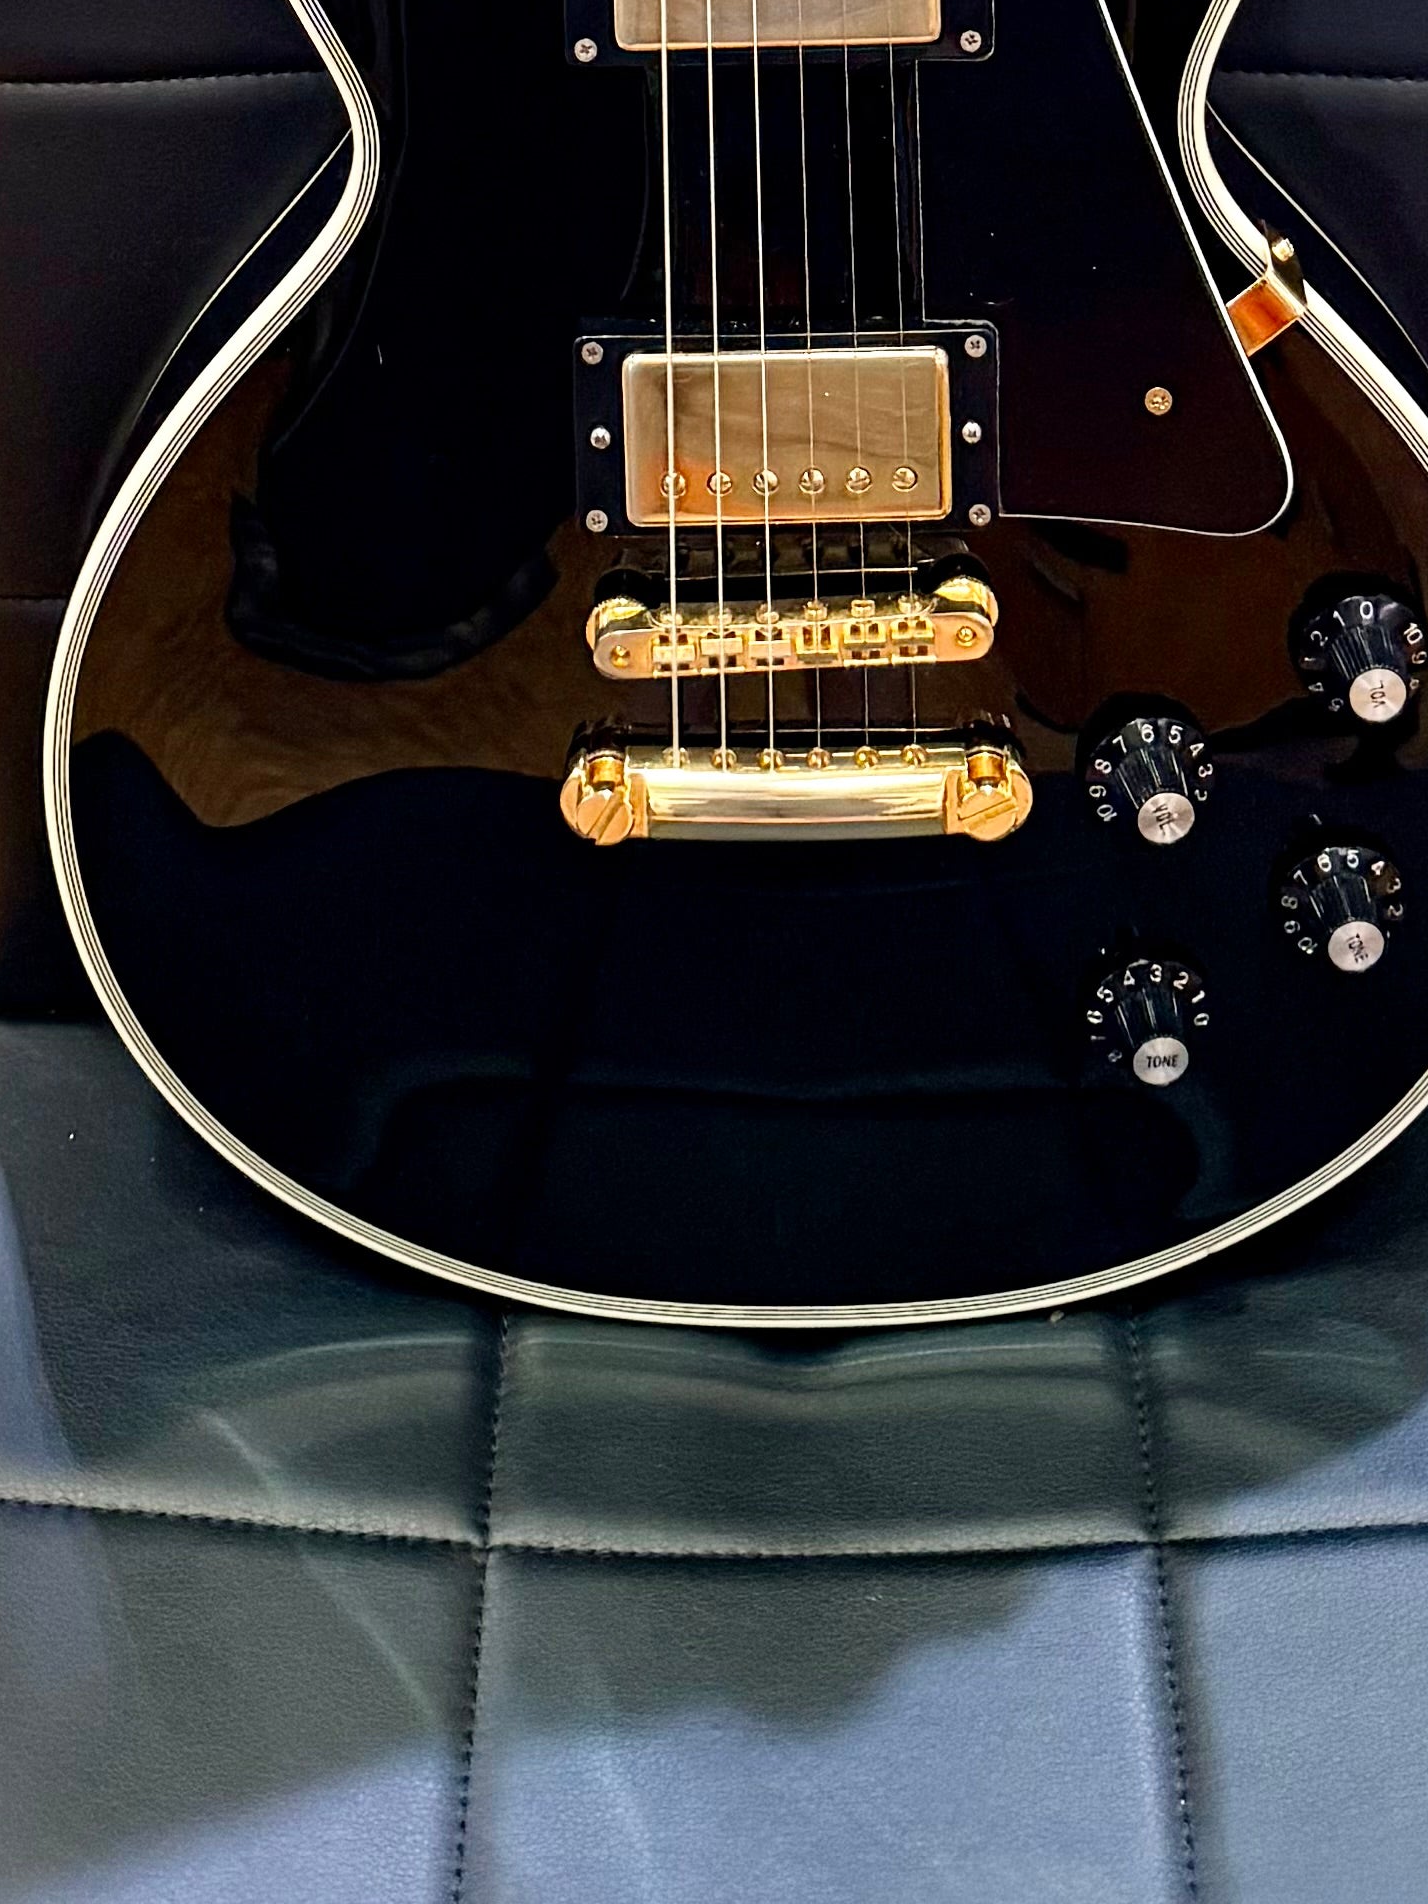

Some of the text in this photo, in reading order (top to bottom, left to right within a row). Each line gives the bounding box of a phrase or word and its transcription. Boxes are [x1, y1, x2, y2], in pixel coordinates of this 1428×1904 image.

[1368, 678, 1388, 711] VOL
[1152, 802, 1177, 838] VOL
[1145, 1054, 1180, 1071] TONE
